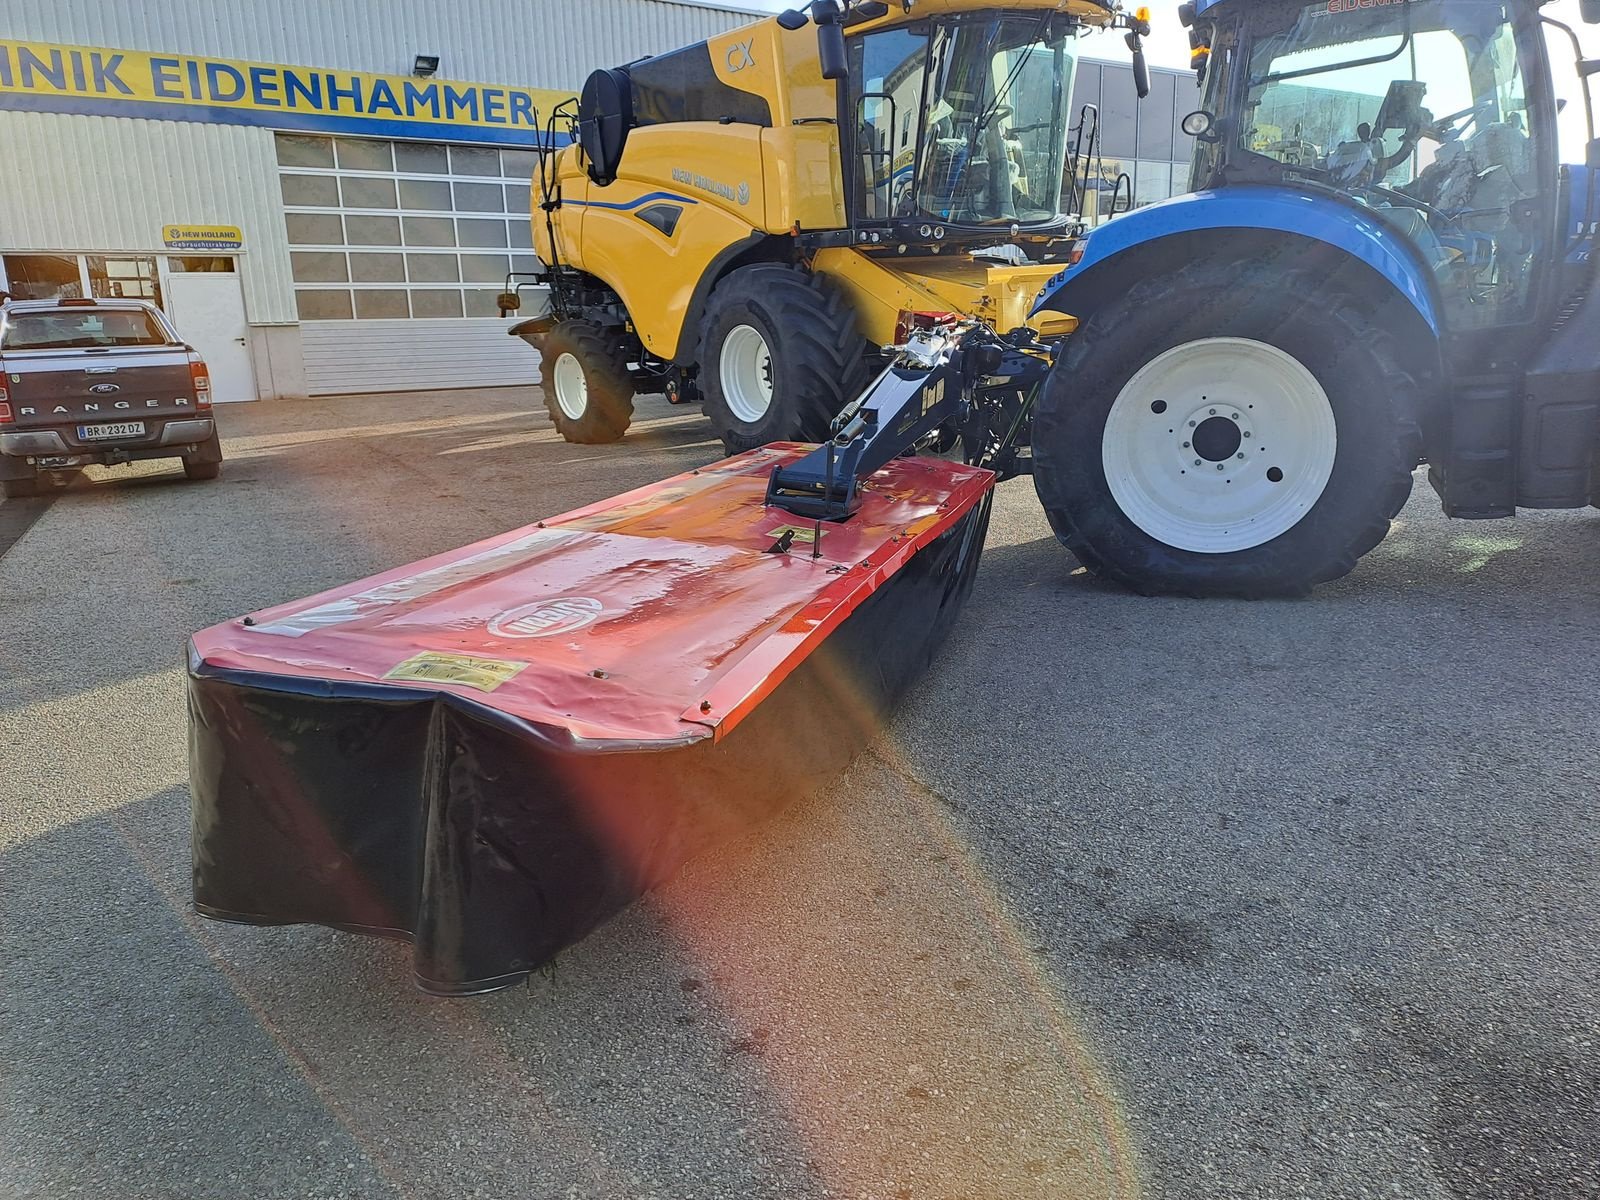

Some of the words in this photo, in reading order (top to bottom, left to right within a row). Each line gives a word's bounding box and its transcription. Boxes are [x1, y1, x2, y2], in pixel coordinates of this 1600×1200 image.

[725, 38, 755, 72] CX
[150, 57, 535, 126] EIDENHAMMER
[672, 168, 692, 185] NEW
[694, 175, 735, 201] HOLLAND
[201, 231, 236, 239] HOLLAND
[21, 398, 188, 415] RANGER
[87, 427, 100, 437] BR
[106, 425, 127, 435] 232
[128, 424, 142, 433] DZ
